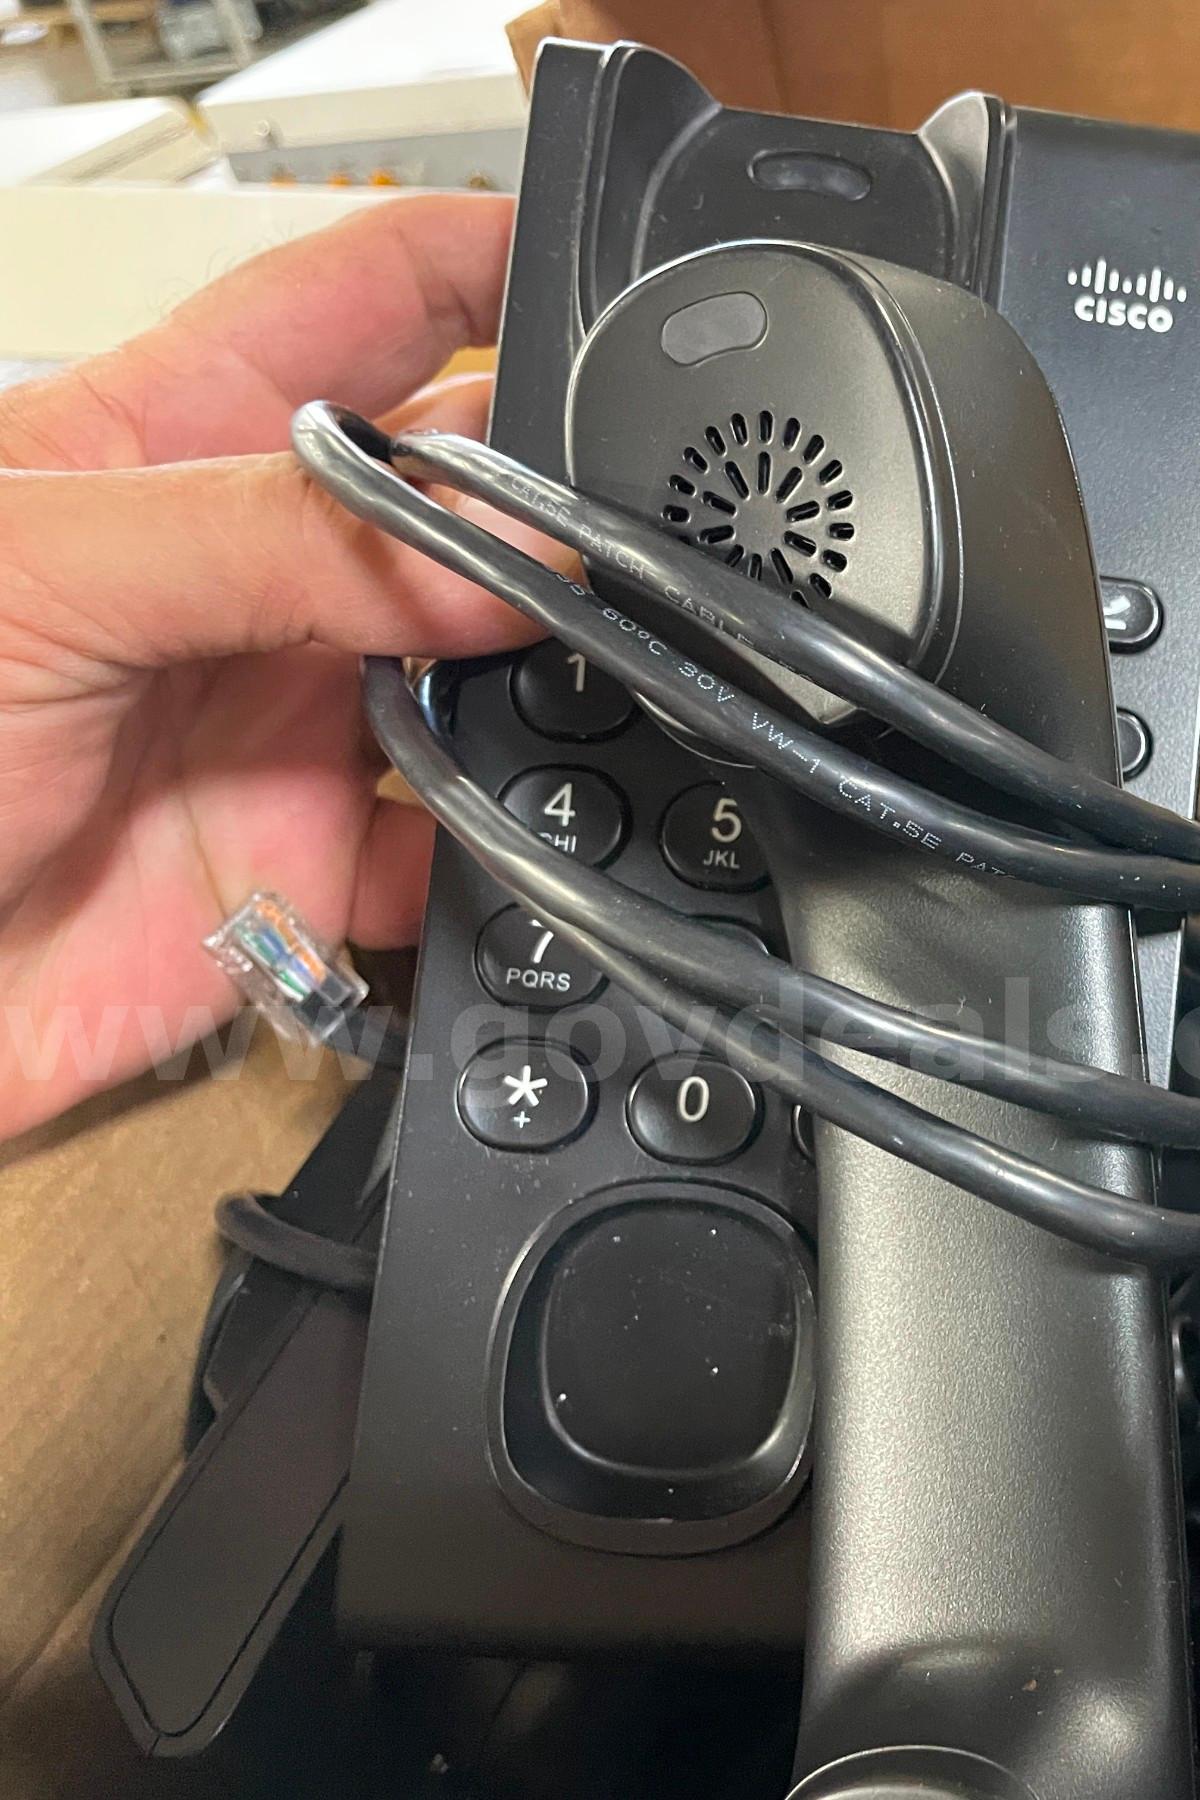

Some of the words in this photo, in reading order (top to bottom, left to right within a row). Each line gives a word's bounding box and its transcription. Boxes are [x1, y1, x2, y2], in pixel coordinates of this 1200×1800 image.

[579, 523, 646, 580] PATCH
[567, 653, 587, 693] 1
[678, 661, 736, 703] 30V
[752, 712, 821, 774] VW-1
[838, 774, 943, 850] CAT.5E
[544, 782, 576, 827] 4
[711, 799, 742, 843] 5
[702, 851, 740, 870] JKL
[529, 919, 554, 964] 7
[506, 967, 571, 992] PQRS
[676, 1075, 711, 1122] 0
